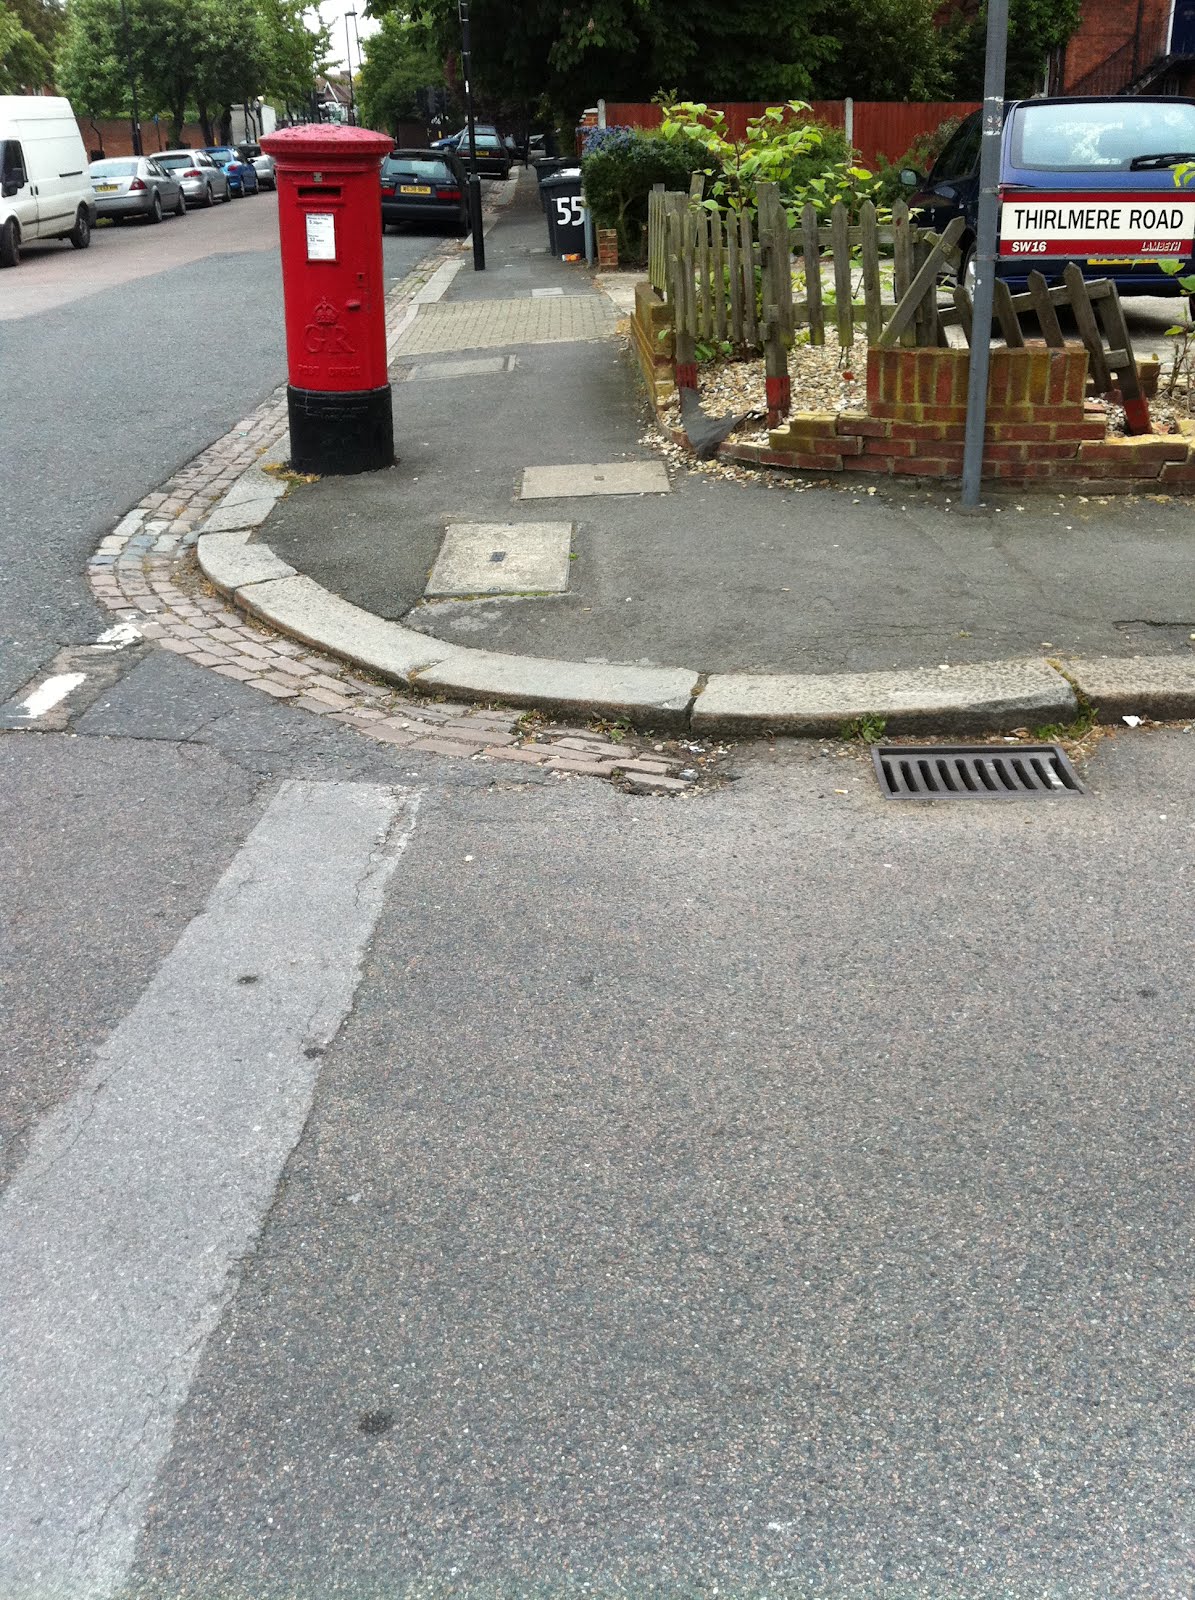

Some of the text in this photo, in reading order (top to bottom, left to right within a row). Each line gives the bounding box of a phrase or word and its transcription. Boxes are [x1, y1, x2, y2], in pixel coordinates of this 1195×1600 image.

[556, 196, 586, 226] 55
[1014, 209, 1184, 230] THIRLMERE ROAD
[1011, 241, 1047, 252] SW16
[1141, 241, 1182, 252] LAMBETH
